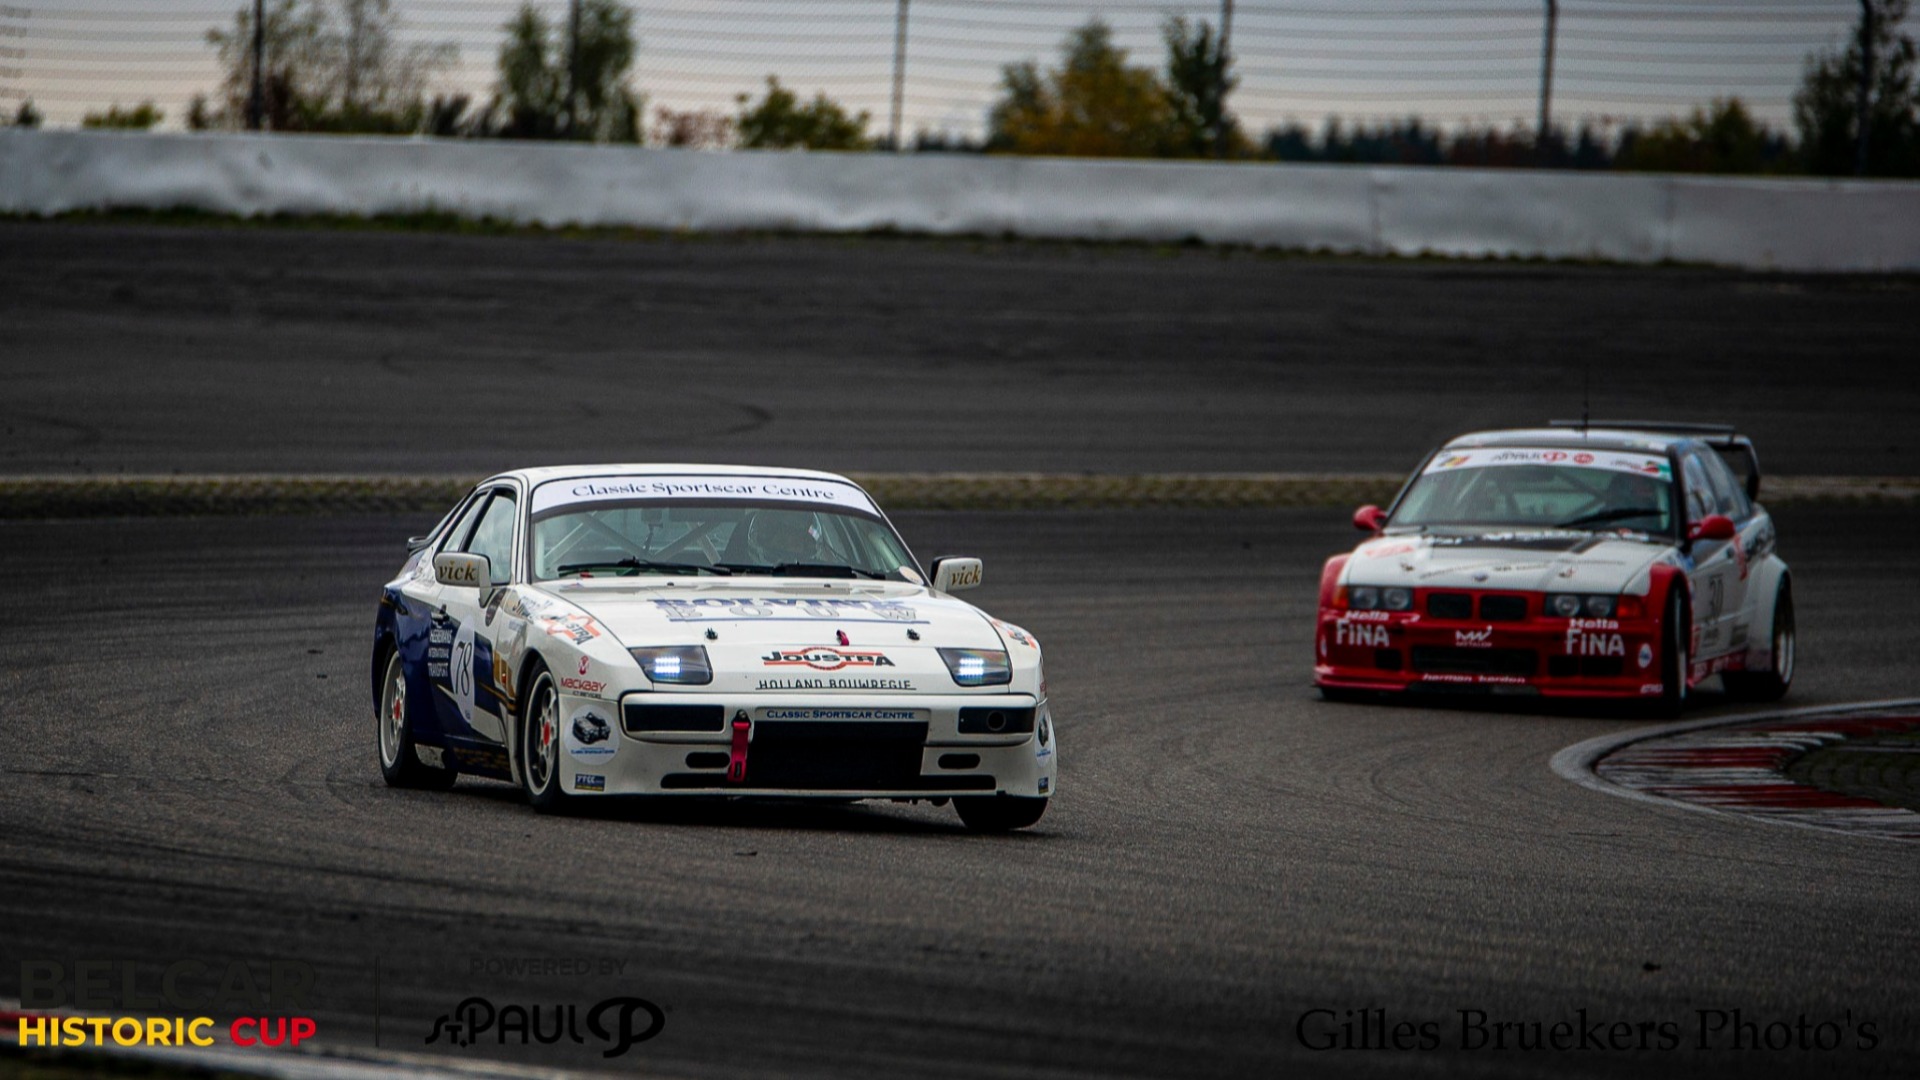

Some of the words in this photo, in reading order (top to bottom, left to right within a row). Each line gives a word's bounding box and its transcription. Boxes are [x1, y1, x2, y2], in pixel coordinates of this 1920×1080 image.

[572, 484, 647, 497] Classic
[653, 482, 756, 496] Sportscar
[763, 484, 835, 500] Centre
[438, 560, 477, 581] vick
[951, 565, 981, 586] vick
[1335, 617, 1390, 647] FINA
[1565, 628, 1626, 656] FINA
[455, 640, 473, 697] 78
[761, 651, 896, 667] JOUSTRA
[758, 679, 823, 690] HOLLAND
[767, 710, 812, 719] CLASSIC
[813, 710, 872, 719] SPORTSCAR
[873, 711, 915, 719] CENTRE
